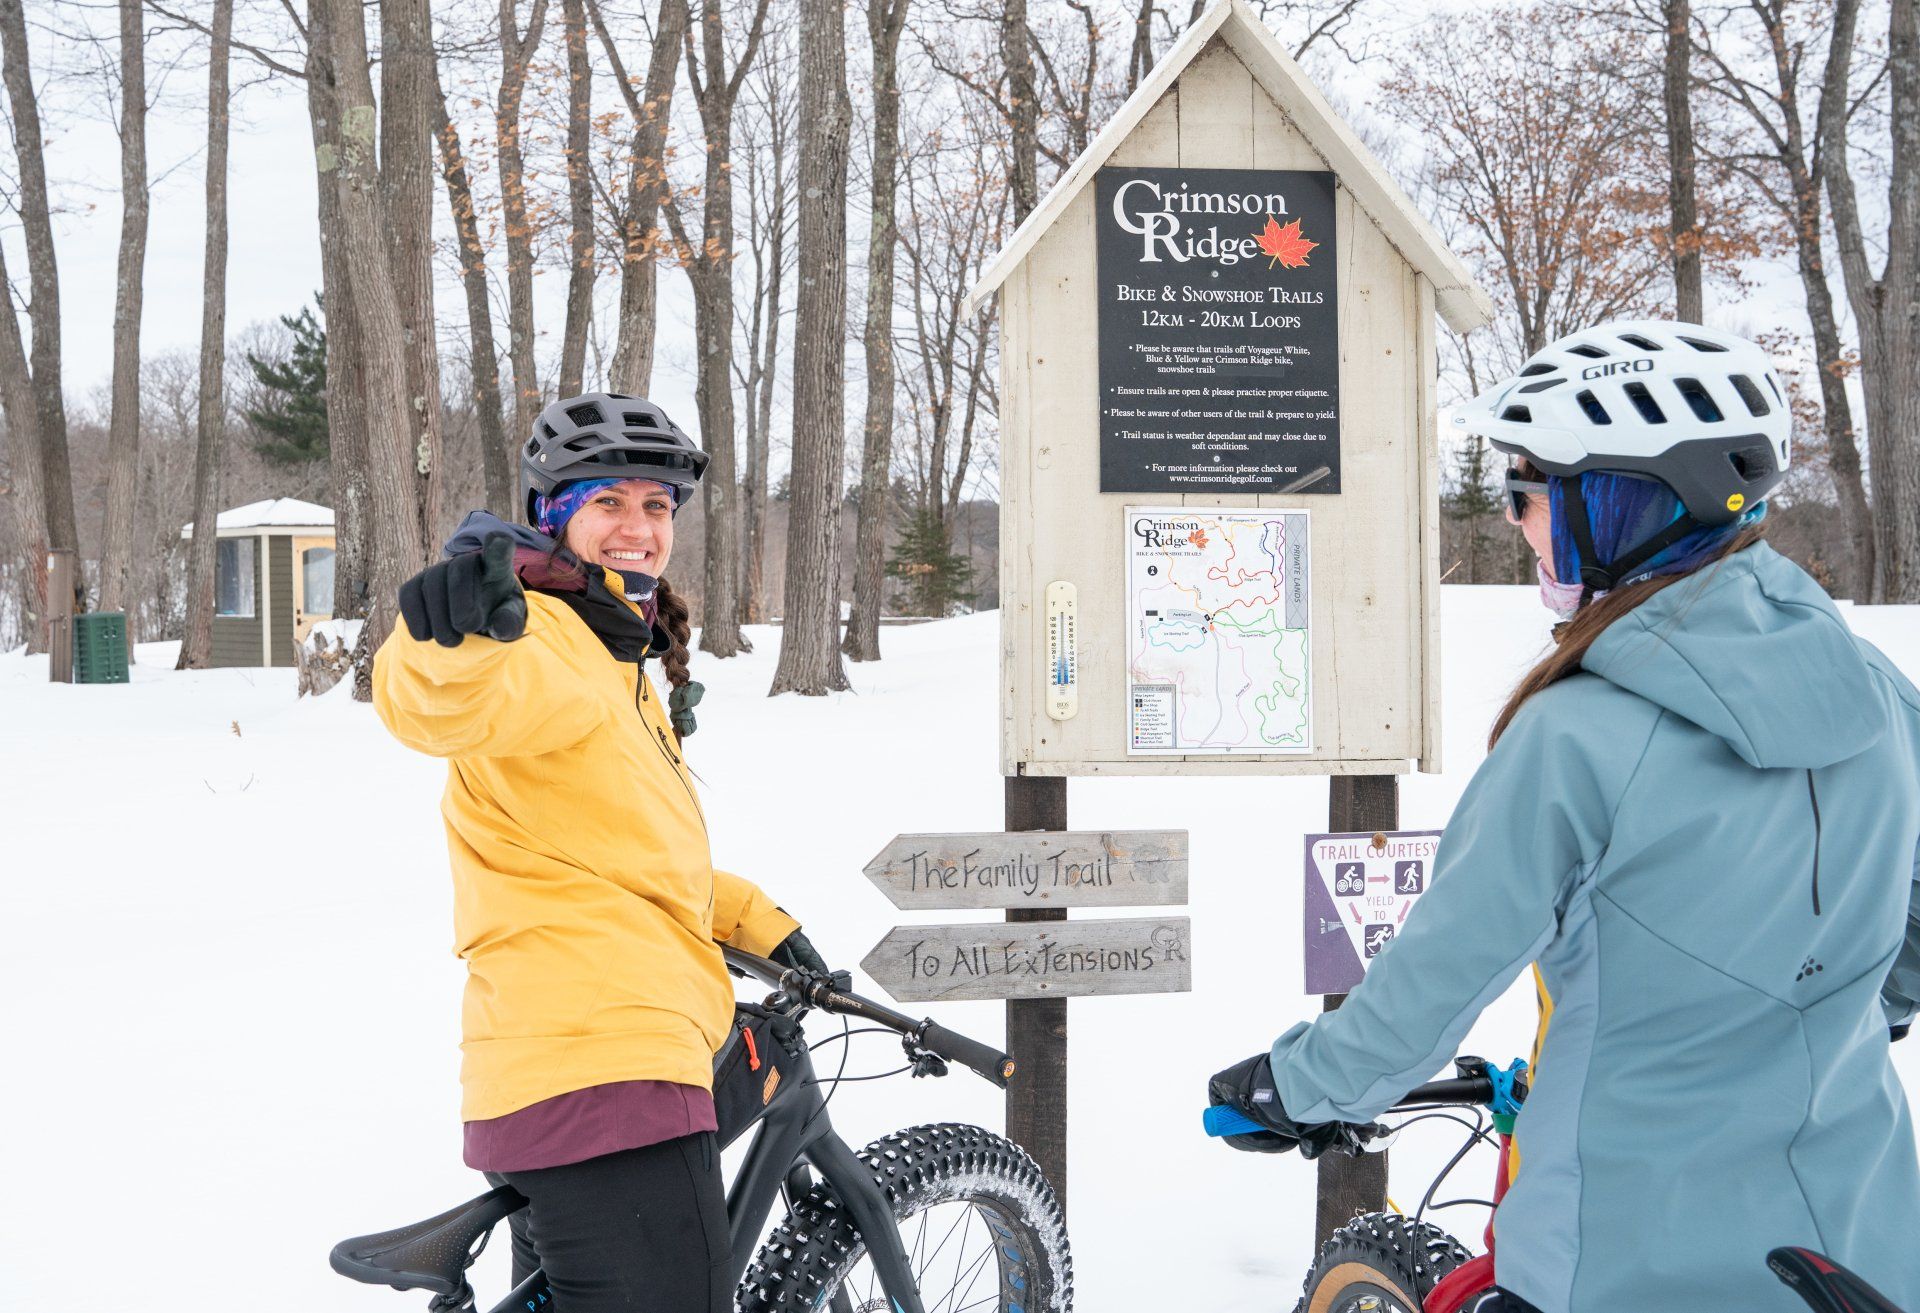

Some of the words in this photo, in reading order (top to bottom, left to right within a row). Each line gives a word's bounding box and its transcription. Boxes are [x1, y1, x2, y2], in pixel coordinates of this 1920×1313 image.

[1113, 180, 1288, 235] Crimson
[1136, 212, 1258, 265] Ridge
[1116, 285, 1157, 301] BIKE
[1162, 285, 1177, 302] &
[1182, 286, 1264, 303] SNOWSHOE
[1268, 287, 1324, 304] TRAILS
[1142, 310, 1184, 327] 12KM
[1201, 311, 1245, 328] 20KM
[1250, 312, 1301, 328] LOOPS
[1136, 344, 1160, 353] Please
[1161, 344, 1171, 353] be
[1196, 345, 1212, 353] that
[1213, 345, 1234, 354] trails
[1235, 345, 1247, 354] off
[1247, 346, 1283, 355] Voyageur
[1284, 346, 1311, 355] White,
[1145, 354, 1164, 363] Blue
[1165, 354, 1172, 363] &
[1174, 354, 1200, 363] Yellow
[1215, 355, 1249, 364] Crimson
[1250, 355, 1273, 365] Ridge
[1274, 356, 1294, 366] bike,
[1157, 365, 1195, 374] snowshoe
[1196, 365, 1216, 374] trails
[1582, 359, 1654, 380] GIRO
[1117, 386, 1145, 395] Ensure
[1146, 387, 1167, 395] trails
[1182, 389, 1201, 397] open
[1202, 387, 1210, 396] &
[1212, 388, 1235, 397] please
[1236, 388, 1267, 398] practice
[1268, 390, 1294, 398] proper
[1294, 388, 1330, 398] etiquette.
[1111, 408, 1135, 417] Please
[1136, 408, 1146, 417] be
[1171, 409, 1181, 418] of
[1181, 409, 1202, 418] other
[1224, 410, 1234, 418] of
[1234, 410, 1247, 418] the
[1248, 410, 1265, 418] trail
[1267, 410, 1274, 419] &
[1276, 412, 1305, 420] prepare
[1315, 410, 1336, 420] yield.
[1121, 431, 1141, 439] Trail
[1142, 432, 1165, 440] status
[1166, 431, 1174, 440] is
[1174, 431, 1205, 440] weather
[1248, 432, 1263, 440] and
[1264, 434, 1281, 442] may
[1282, 432, 1302, 441] close
[1302, 432, 1317, 441] due
[1192, 441, 1206, 450] soft
[1207, 442, 1250, 450] conditions.
[1152, 463, 1167, 472] For
[1189, 464, 1235, 472] information
[1236, 464, 1260, 474] please
[1260, 464, 1283, 473] check
[1169, 474, 1273, 484] www.crimsonridgegolf.com
[1134, 518, 1199, 537] Crimson
[1143, 529, 1188, 548] Ridge
[1320, 845, 1360, 860] TRAIL
[1366, 842, 1438, 859] COURTESY
[902, 850, 958, 892] The
[963, 848, 1039, 896] Family
[1046, 850, 1112, 887] Trail
[1366, 896, 1394, 906] YIELD
[1374, 910, 1386, 921] TO
[904, 941, 940, 978] To
[950, 945, 989, 976] All
